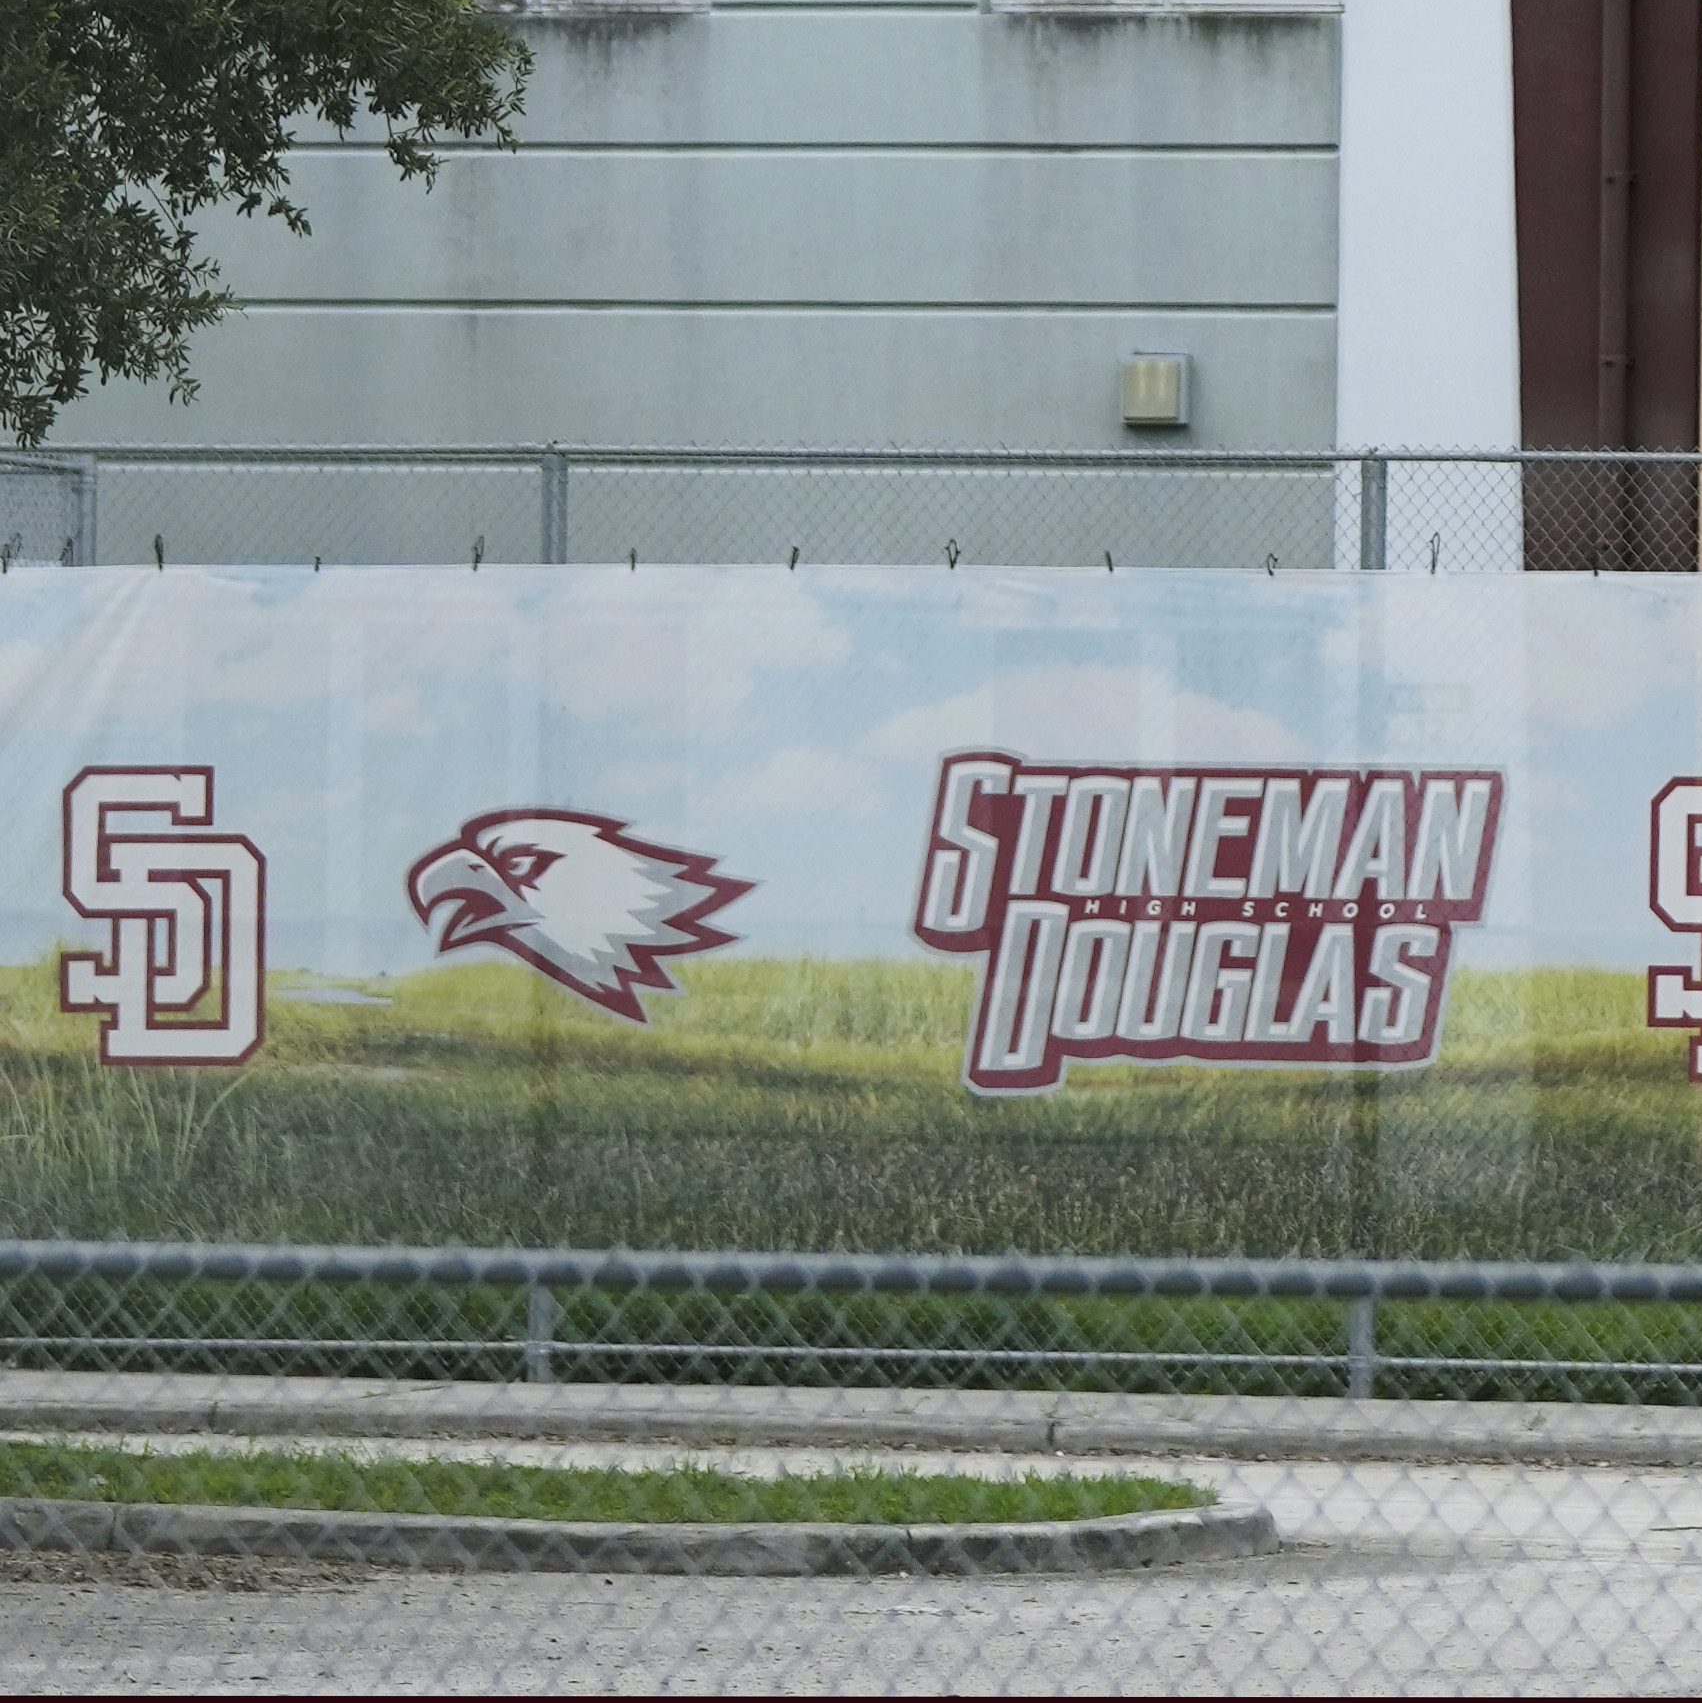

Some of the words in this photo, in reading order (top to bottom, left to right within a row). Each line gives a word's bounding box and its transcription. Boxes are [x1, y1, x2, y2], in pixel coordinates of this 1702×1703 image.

[922, 759, 1493, 933] STONEMAN
[1085, 899, 1197, 918] HIGH
[1241, 899, 1430, 920] SCHOOL
[977, 900, 1440, 1072] DOUGLAS
